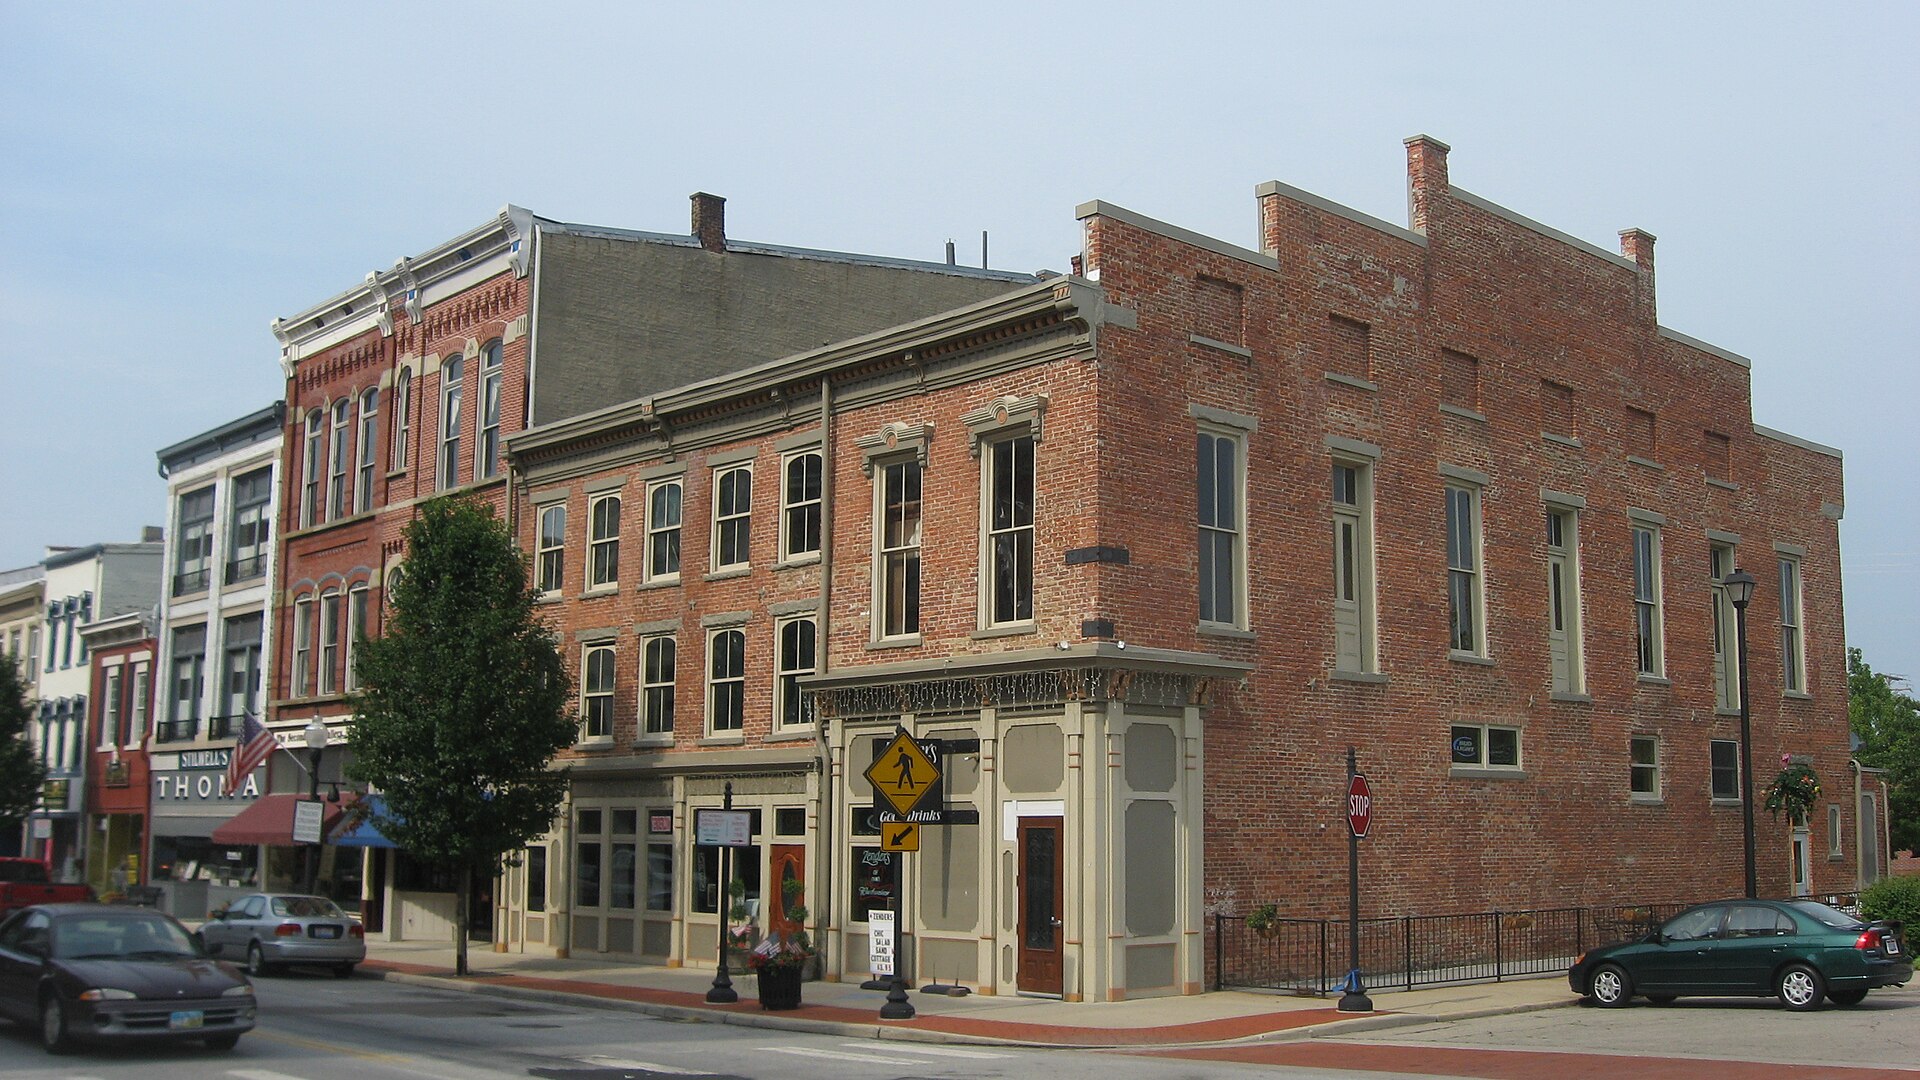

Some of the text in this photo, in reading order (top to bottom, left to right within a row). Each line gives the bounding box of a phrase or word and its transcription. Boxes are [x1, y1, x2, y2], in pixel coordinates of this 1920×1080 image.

[1350, 794, 1369, 817] STOP
[875, 938, 890, 946] SALAD
[871, 955, 891, 963] COTTAGE
